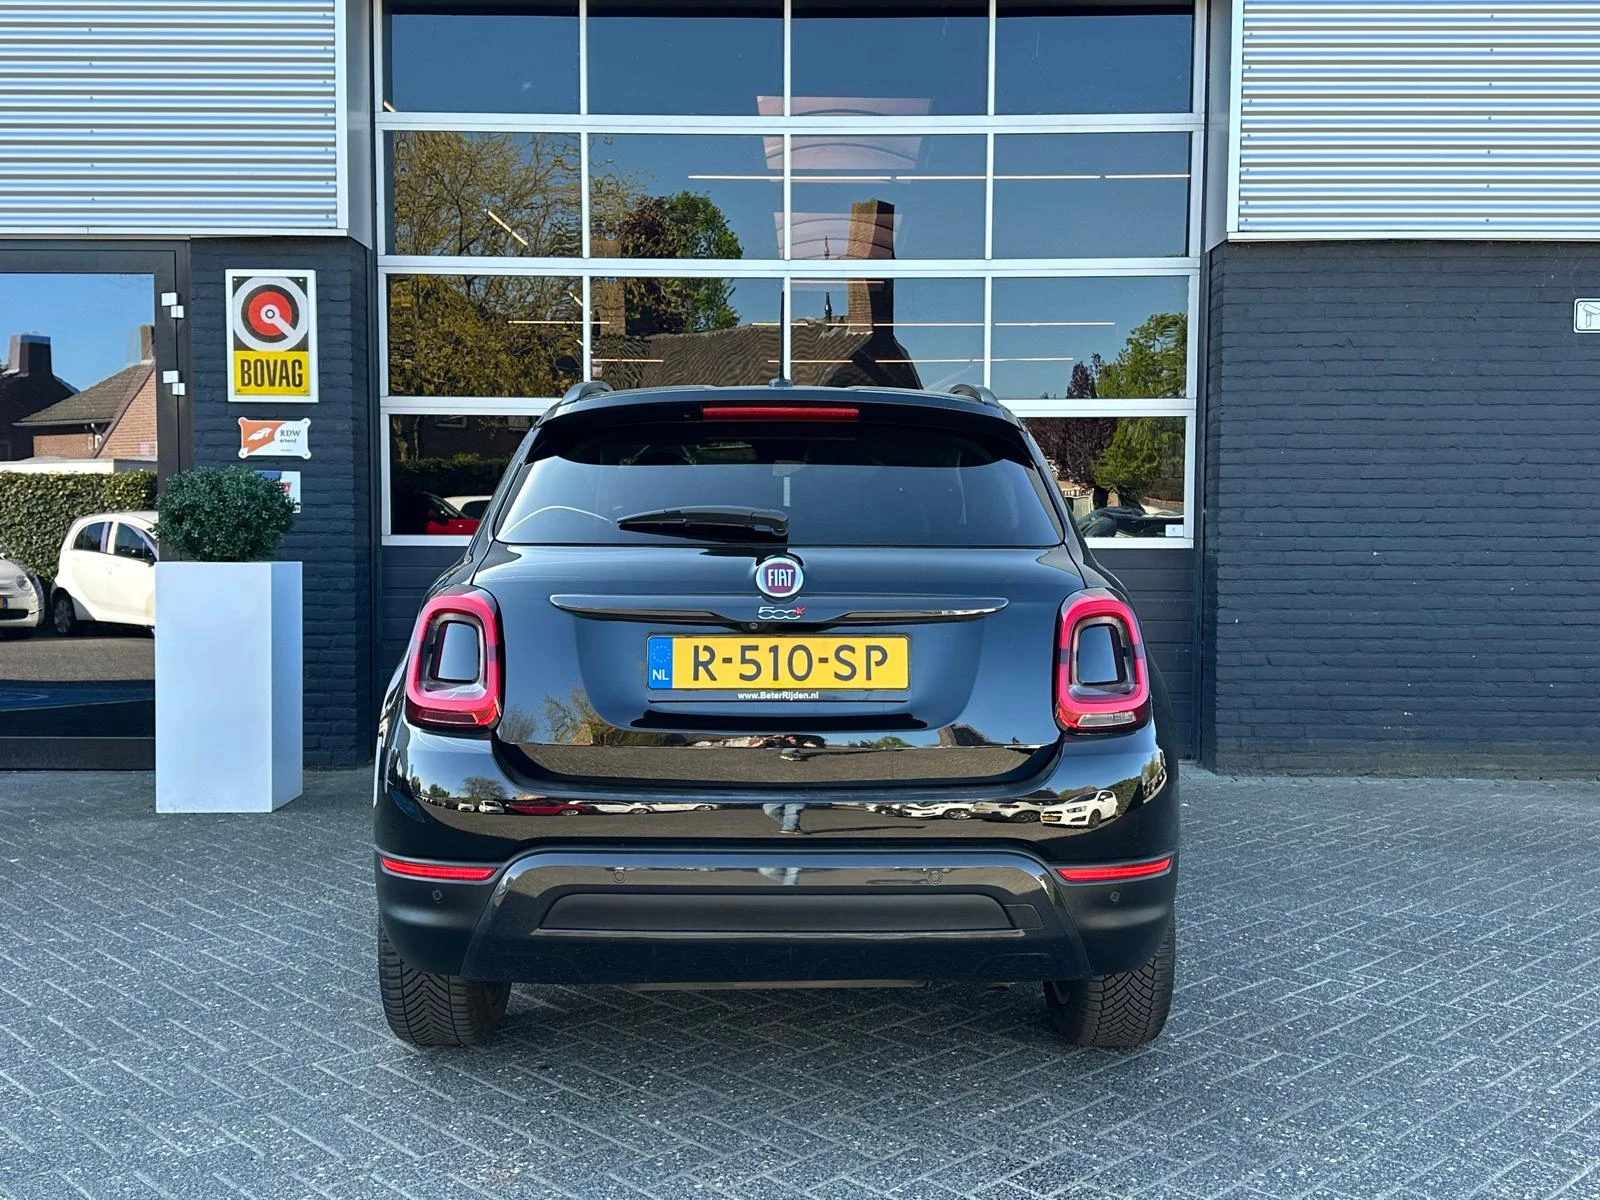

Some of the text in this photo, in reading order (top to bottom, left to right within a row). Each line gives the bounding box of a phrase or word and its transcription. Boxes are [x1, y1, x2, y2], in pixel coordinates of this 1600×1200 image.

[240, 358, 303, 388] BOVAG
[280, 429, 301, 437] RDW
[768, 568, 794, 587] FIAT
[692, 644, 888, 682] R-510-SP
[652, 669, 670, 681] NL
[737, 691, 819, 701] www.BeterRijden.nl
